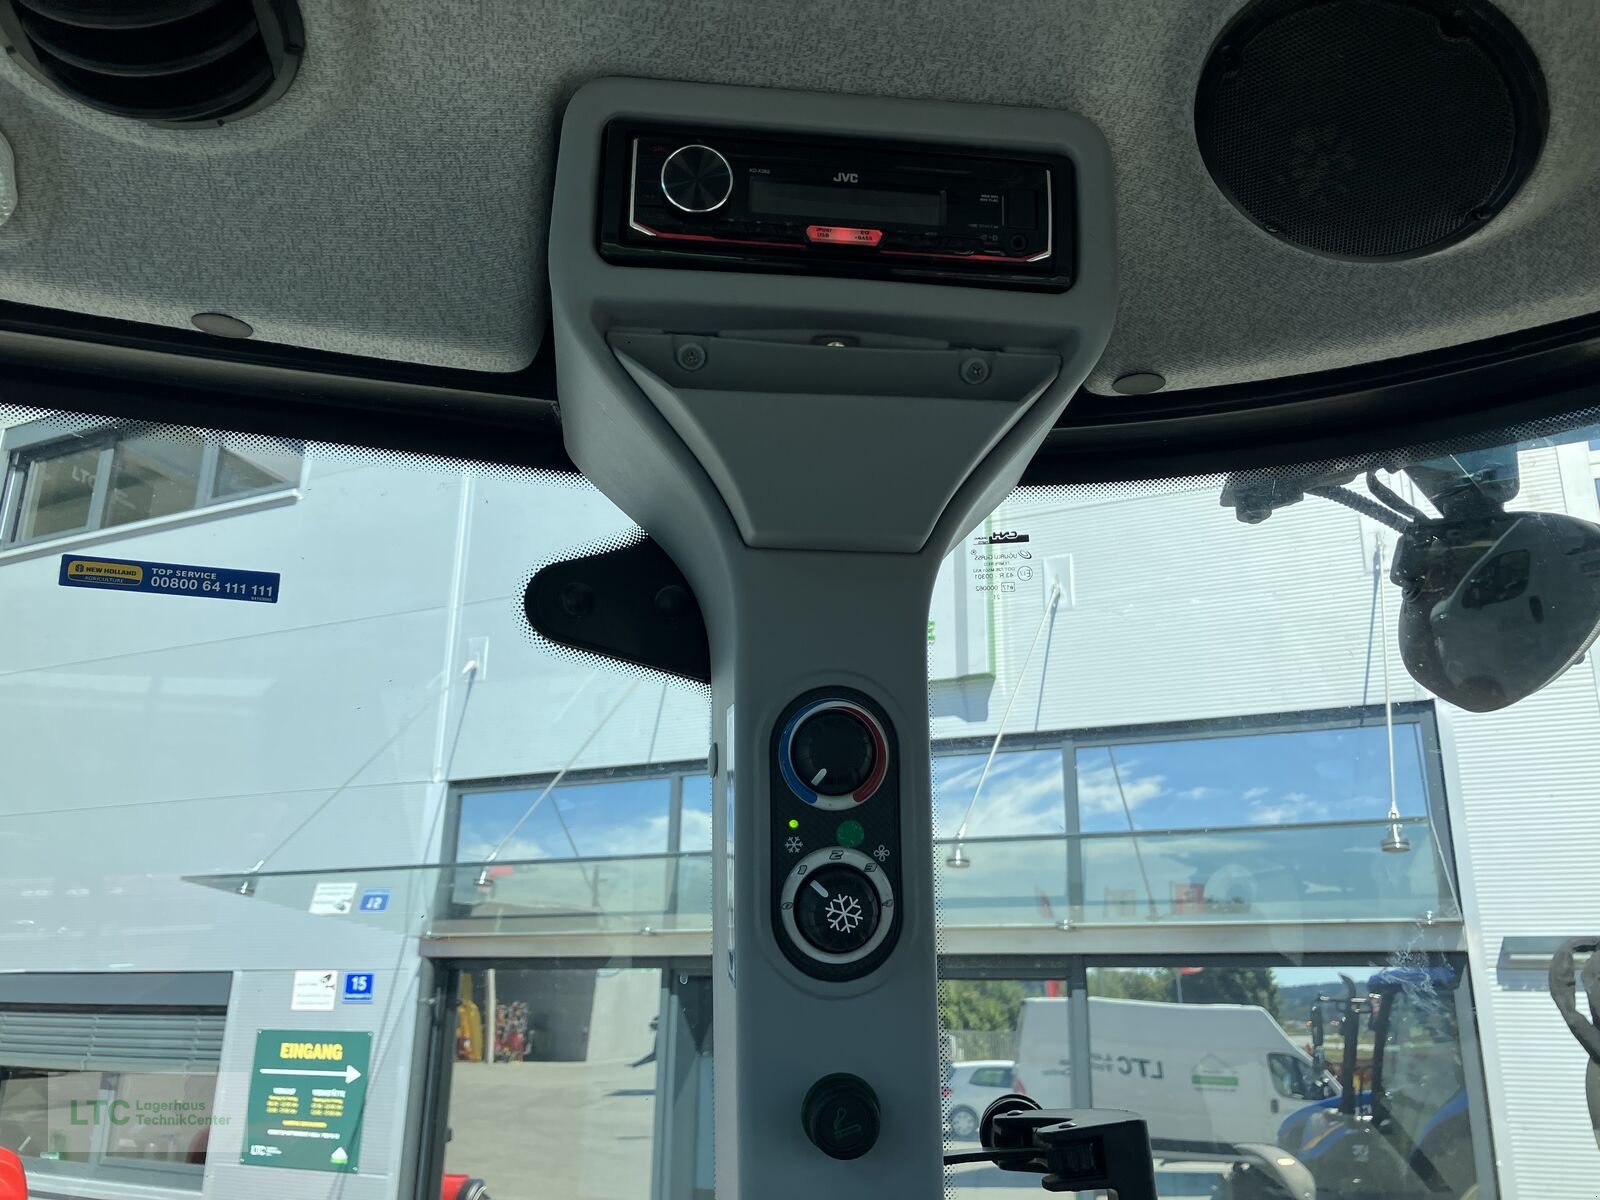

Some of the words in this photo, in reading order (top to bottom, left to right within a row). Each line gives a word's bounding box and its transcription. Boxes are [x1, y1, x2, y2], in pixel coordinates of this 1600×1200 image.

[832, 172, 859, 184] JVC
[104, 567, 137, 576] HOLLAND
[152, 567, 173, 577] TOP
[175, 570, 217, 580] SERVICE
[151, 576, 198, 590] 00800
[202, 580, 221, 592] 64
[224, 583, 246, 594] 111
[251, 585, 273, 597] 111
[829, 850, 844, 860] 2
[351, 975, 368, 991] 15
[280, 1042, 343, 1061] EINGANG
